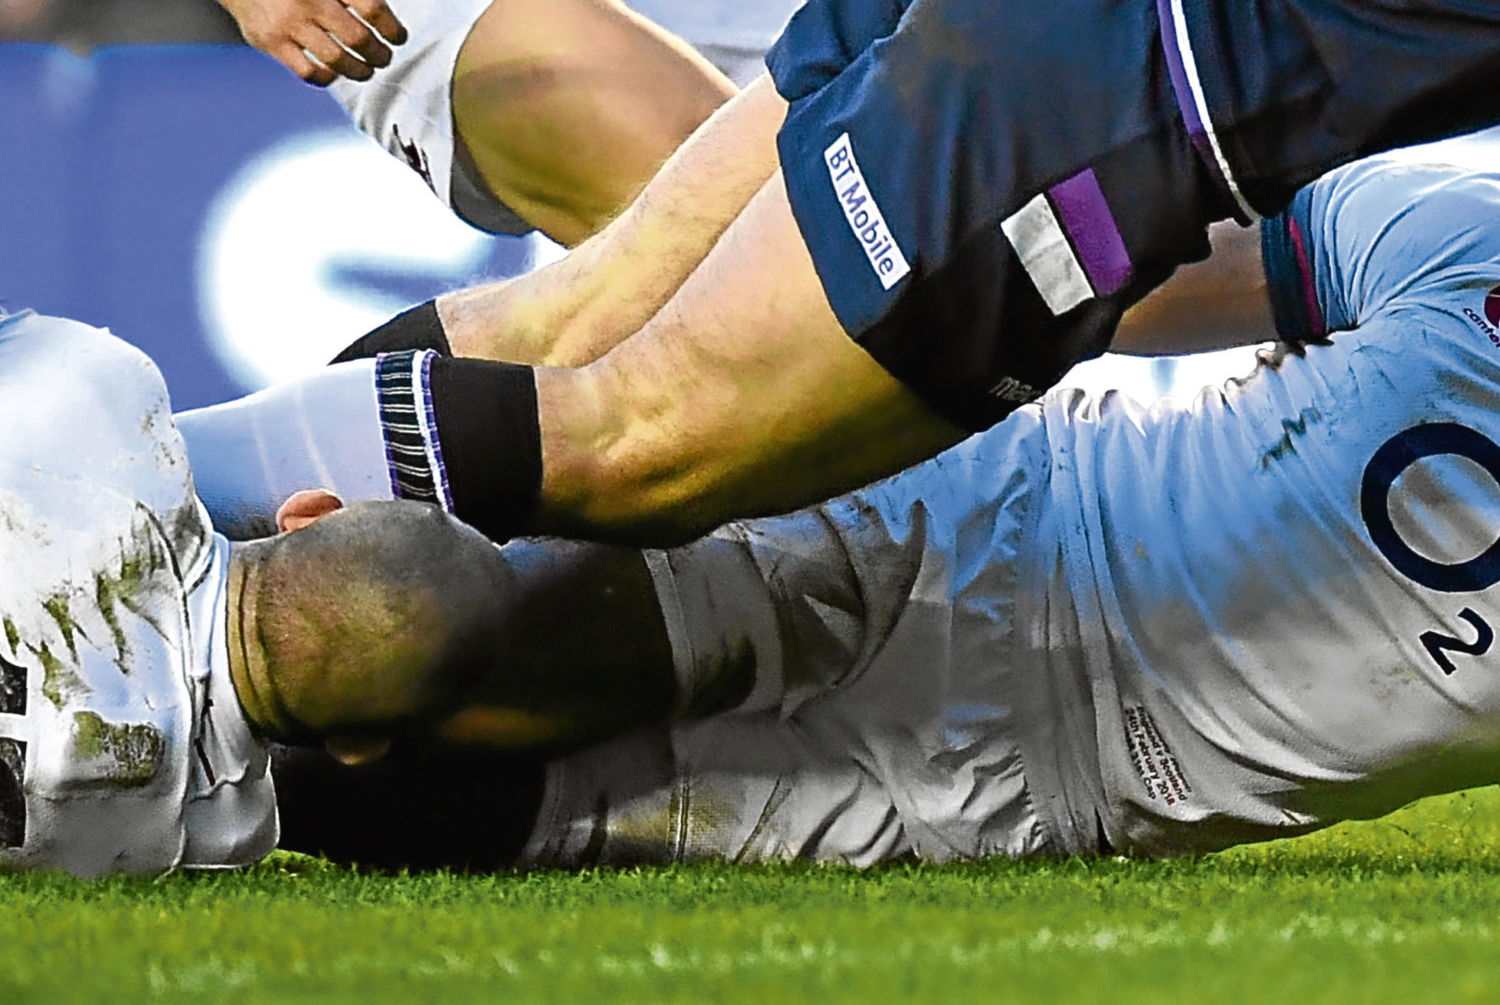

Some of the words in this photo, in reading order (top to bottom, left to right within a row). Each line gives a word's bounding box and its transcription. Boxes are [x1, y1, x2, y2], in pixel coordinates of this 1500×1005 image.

[830, 146, 855, 181] BT
[842, 181, 895, 276] Mobile
[1135, 734, 1160, 780] February
[1143, 777, 1156, 800] Cap
